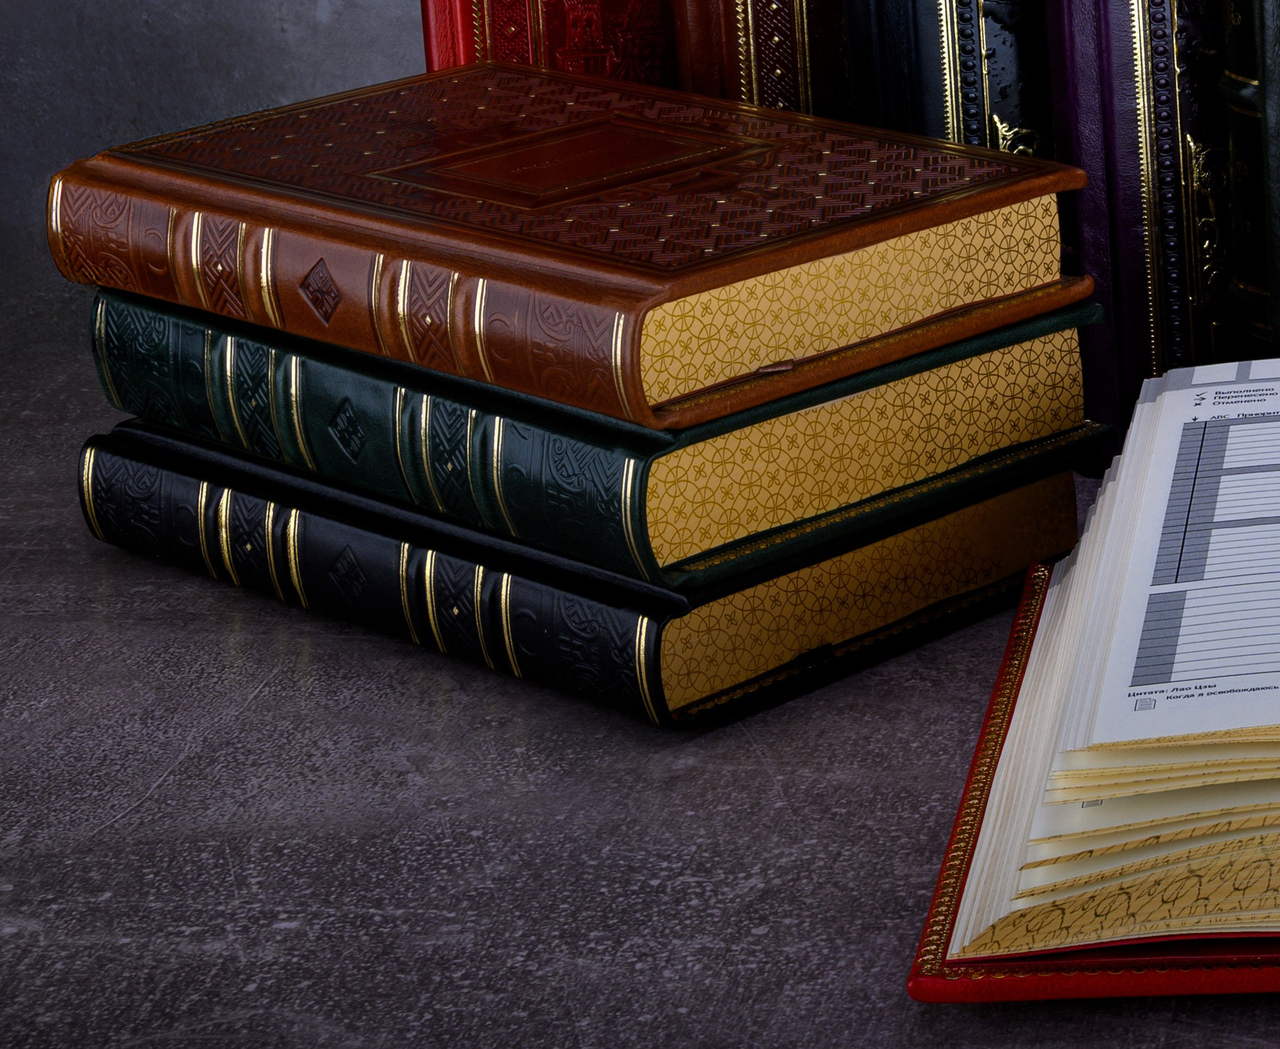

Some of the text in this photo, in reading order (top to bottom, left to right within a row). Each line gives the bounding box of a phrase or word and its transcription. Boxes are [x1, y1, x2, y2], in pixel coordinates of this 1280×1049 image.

[1213, 391, 1279, 400] Перенесено
[1214, 387, 1275, 396] Выполнено
[1212, 398, 1267, 406] Отменено
[1127, 690, 1168, 698] Цитата:
[1165, 693, 1195, 701] Когда
[1206, 685, 1280, 696] освобождаюсь
